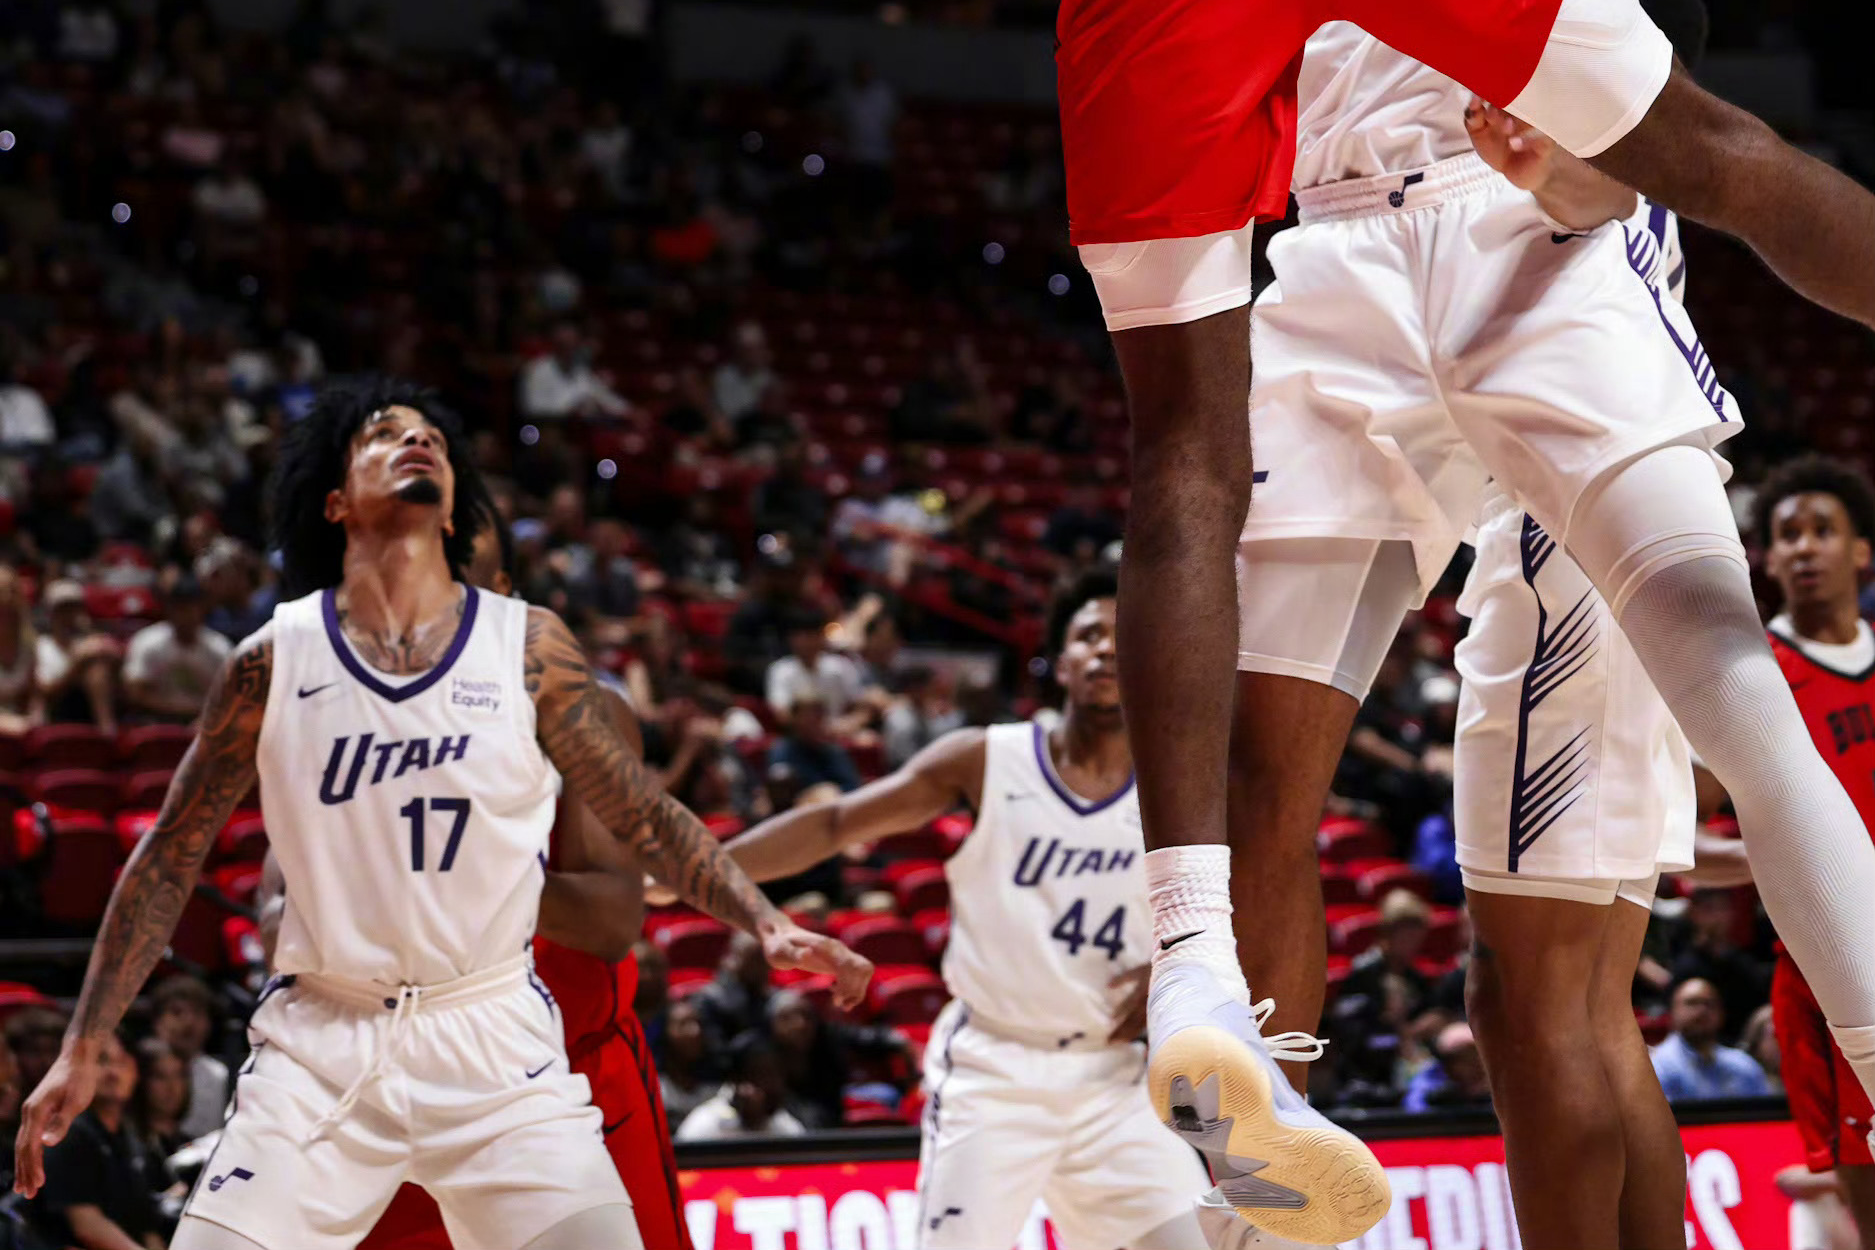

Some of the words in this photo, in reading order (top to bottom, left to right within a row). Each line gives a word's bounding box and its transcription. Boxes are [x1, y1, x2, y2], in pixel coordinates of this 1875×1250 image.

[452, 691, 500, 714] Equity
[319, 732, 473, 806] UTAH
[400, 796, 472, 872] 17
[1013, 836, 1136, 887] UTAH
[1051, 897, 1127, 961] 44
